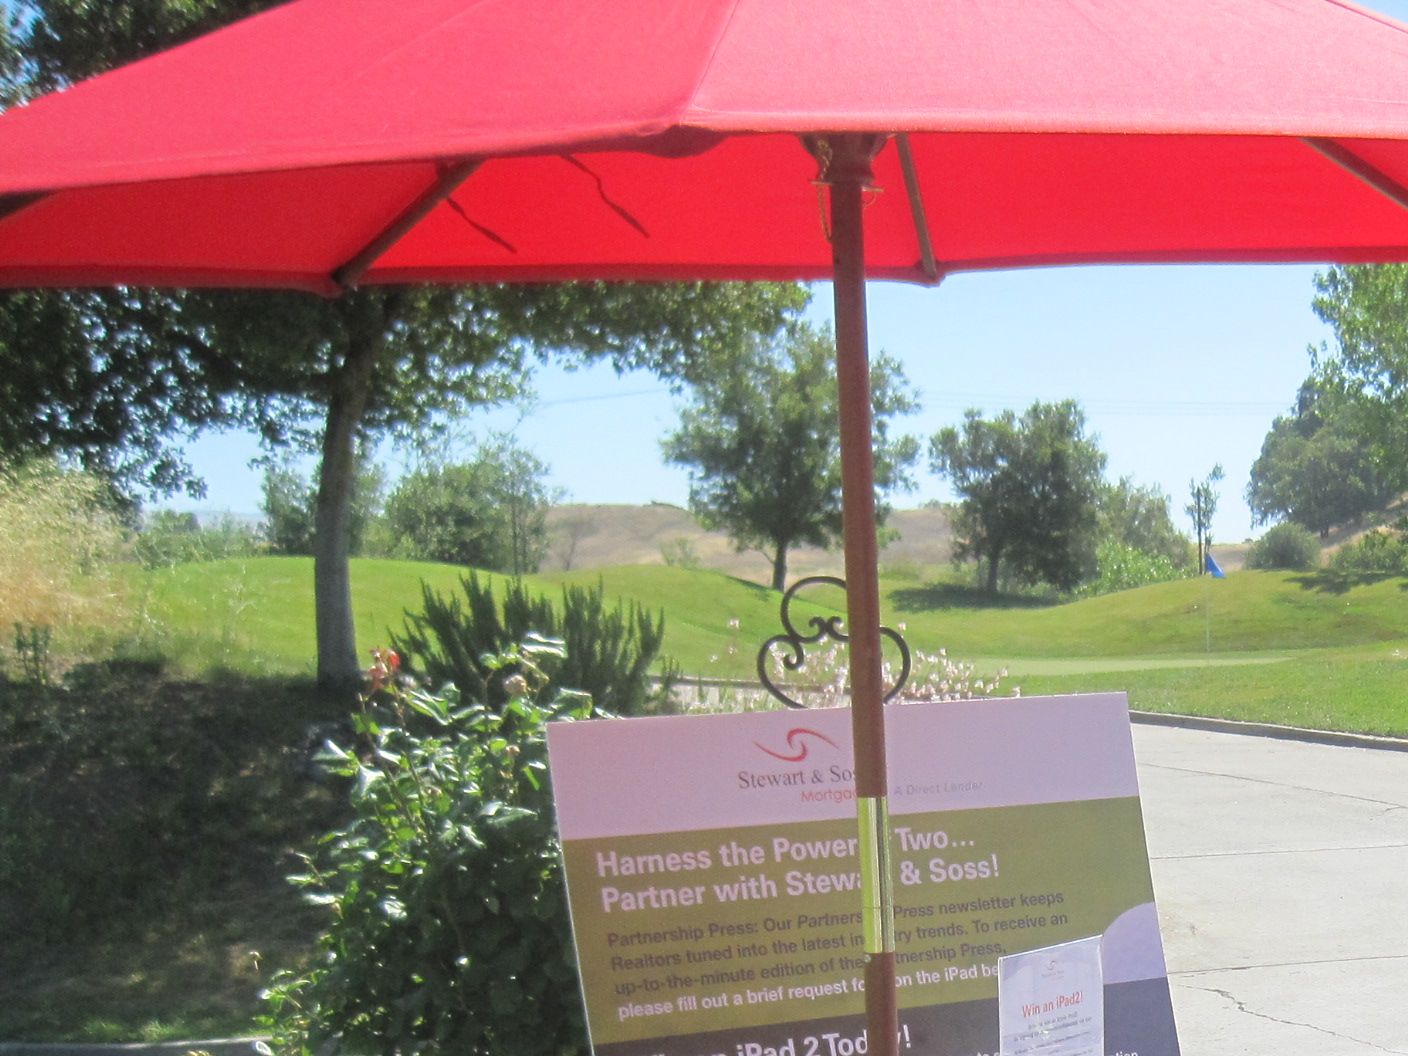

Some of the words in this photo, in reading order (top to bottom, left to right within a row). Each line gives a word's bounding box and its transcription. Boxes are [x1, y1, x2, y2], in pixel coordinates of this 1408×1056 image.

[738, 767, 805, 790] Stewart
[811, 769, 824, 784] &
[830, 765, 856, 783] So
[801, 786, 858, 804] Mortga
[596, 849, 712, 878] Harness
[718, 841, 765, 867] the
[772, 837, 858, 863] Power
[895, 827, 975, 852] Two...
[601, 886, 706, 913] Partner
[713, 873, 778, 902] with
[900, 860, 922, 886] &
[929, 853, 999, 883] Soss!
[607, 926, 704, 947] Partnership
[708, 922, 759, 938] Press:
[763, 917, 792, 932] Our
[893, 904, 934, 920] Press
[939, 895, 1016, 915] newsletter
[1019, 892, 1065, 908] keeps
[611, 953, 681, 972] Realtors
[686, 945, 733, 963] tuned
[737, 944, 768, 958] into
[772, 940, 797, 955] the
[802, 935, 847, 952] latest
[916, 922, 969, 939] trends.
[971, 920, 990, 935] To
[994, 916, 1047, 931] receive
[1050, 914, 1068, 925] an
[615, 968, 756, 997] up-to-the-minute
[760, 963, 815, 979] edition
[819, 960, 835, 973] of
[839, 956, 863, 971] the
[618, 1002, 673, 1022] please
[677, 995, 698, 1012] fill
[701, 993, 729, 1009] out
[733, 993, 743, 1006] a
[746, 985, 784, 1004] brief
[788, 980, 848, 1000] request
[895, 975, 912, 988] on
[916, 970, 940, 985] the
[944, 964, 978, 982] iPad
[1022, 1004, 1040, 1018] Win
[1043, 1001, 1054, 1013] an
[1056, 991, 1083, 1009] iPad2!
